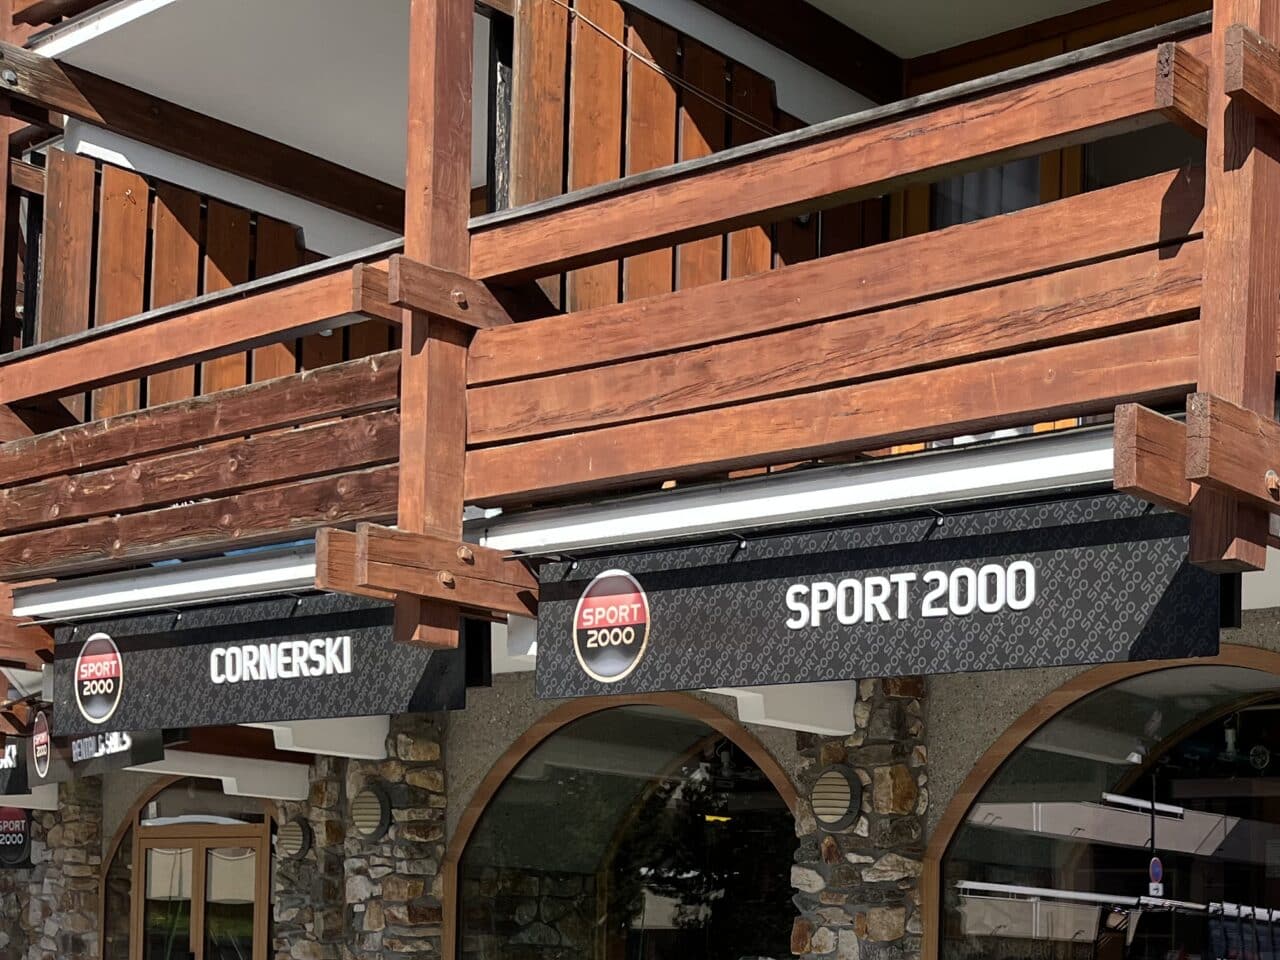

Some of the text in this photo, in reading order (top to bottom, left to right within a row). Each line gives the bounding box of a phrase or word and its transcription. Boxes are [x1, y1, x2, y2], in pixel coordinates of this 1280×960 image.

[785, 560, 1036, 630] SPORT 2000
[582, 603, 641, 627] SPORT
[586, 626, 635, 648] 2000
[80, 660, 118, 679] SPORT
[210, 636, 352, 684] CORNERSKI
[82, 678, 114, 696] 2000
